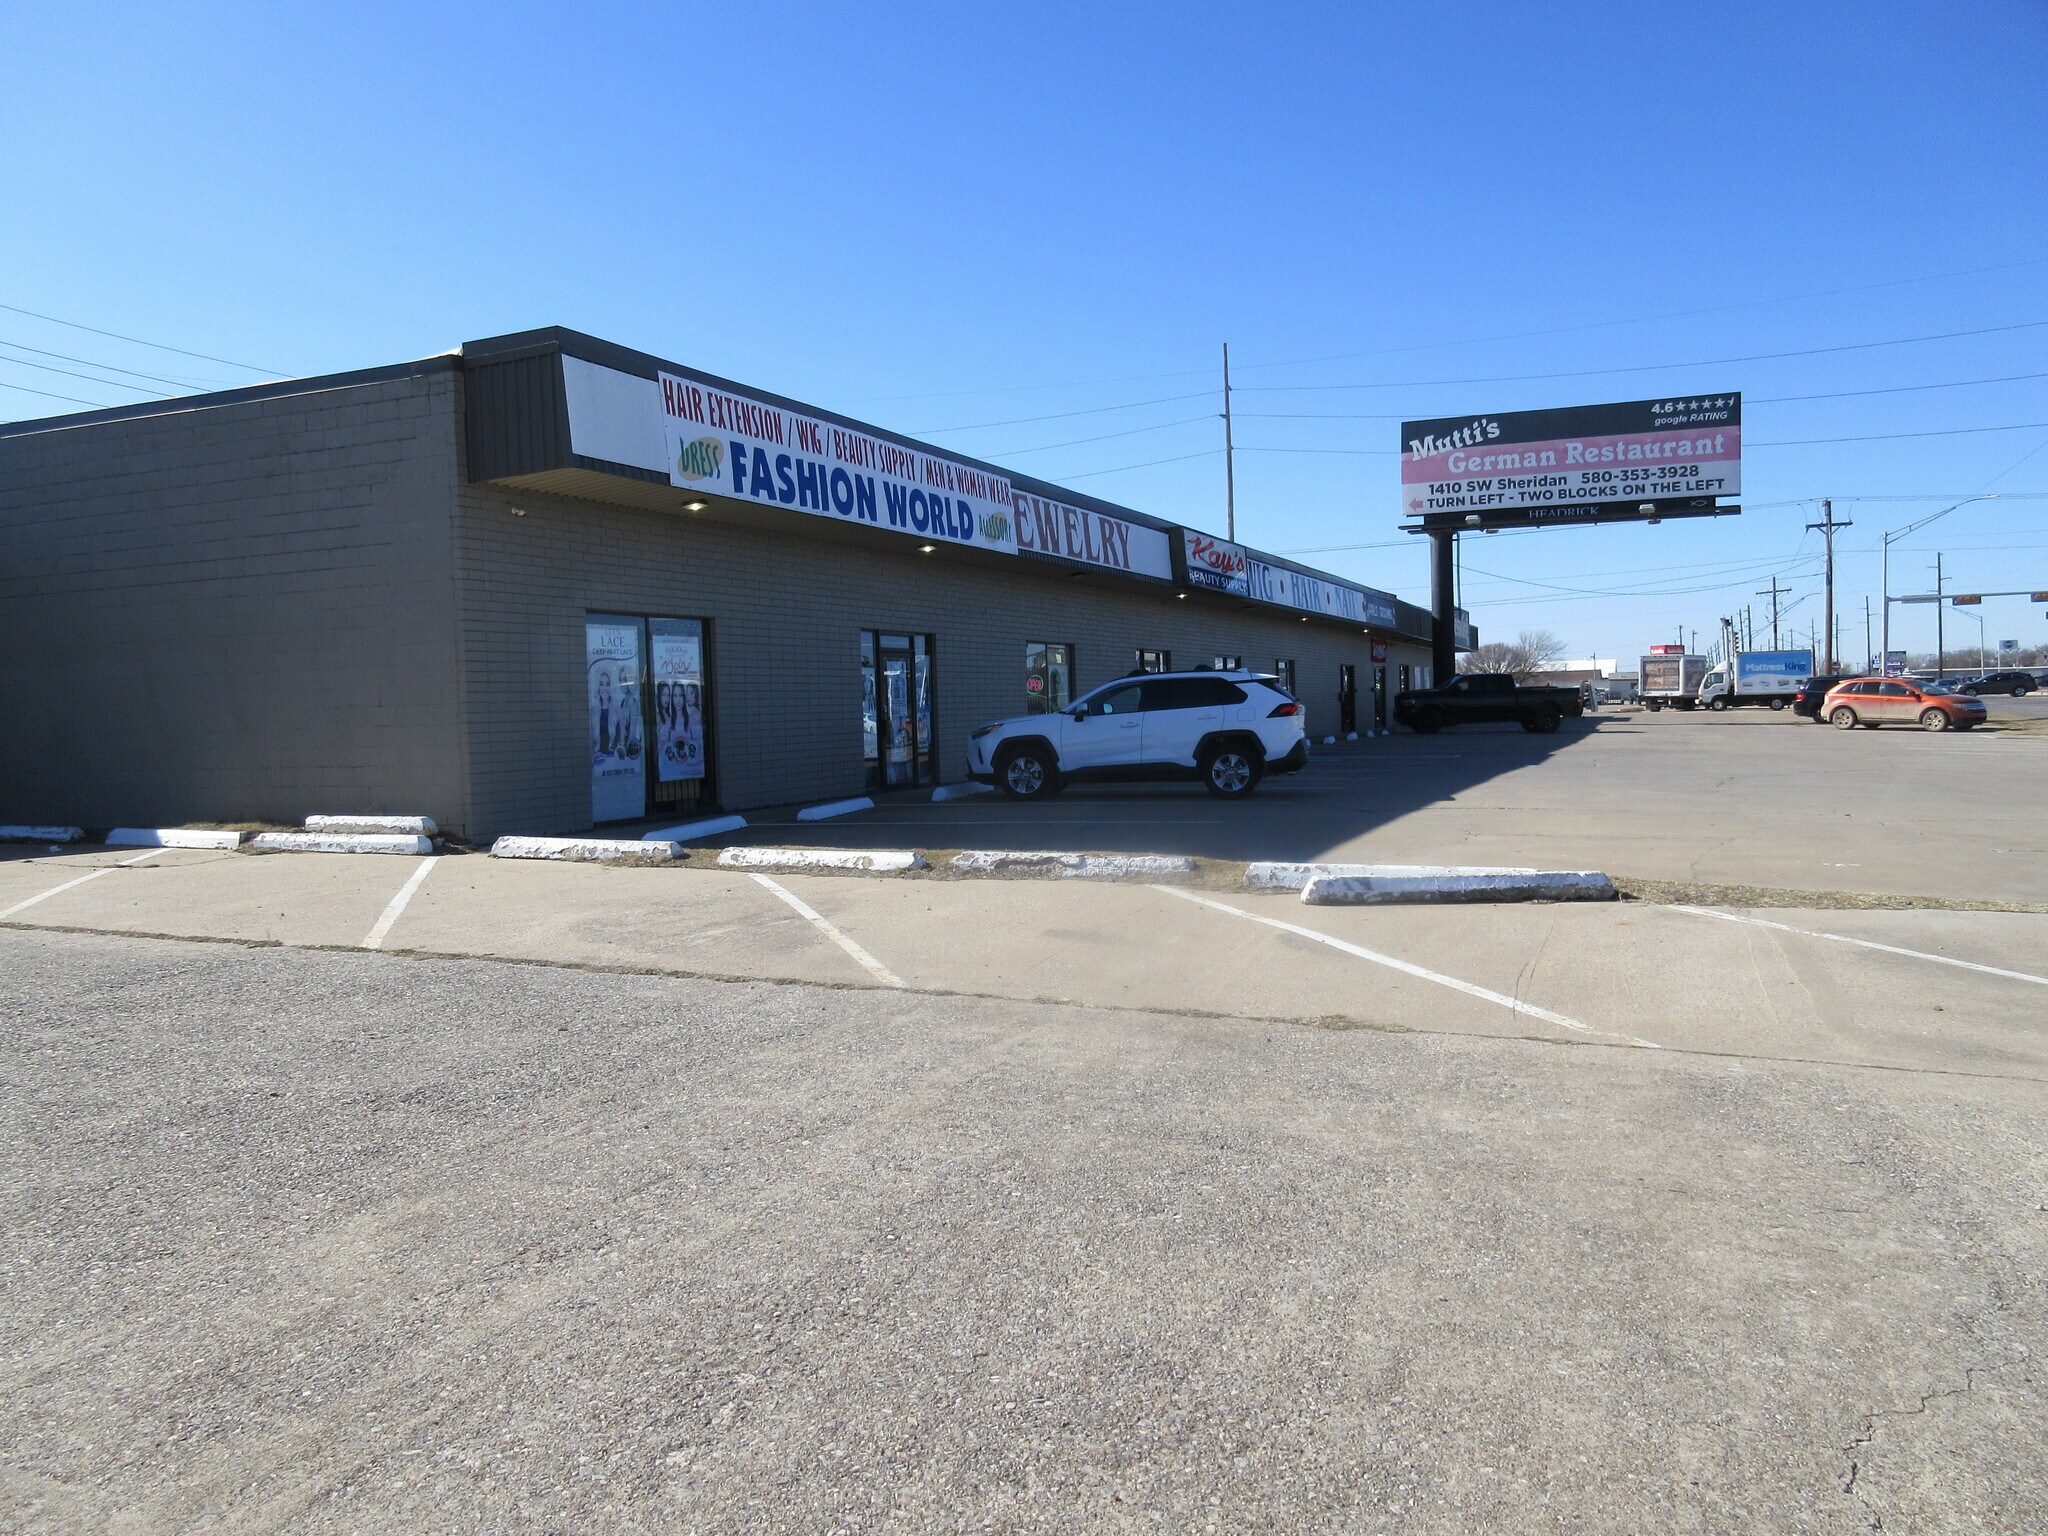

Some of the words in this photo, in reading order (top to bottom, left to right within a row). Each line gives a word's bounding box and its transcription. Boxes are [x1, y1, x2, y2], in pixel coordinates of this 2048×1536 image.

[1651, 402, 1674, 414] 4.6
[1654, 414, 1688, 426] google
[1689, 411, 1728, 422] RATING
[662, 378, 705, 424] HAIR
[706, 391, 784, 445] EXTENSION
[795, 418, 823, 455] WIG
[833, 429, 877, 470] BEAUTY
[878, 443, 916, 481] SUPPLY
[925, 458, 946, 489] MEN
[946, 464, 955, 492] &
[955, 467, 987, 500] WOMEN
[987, 477, 1012, 507] WEAR
[679, 435, 721, 479] DRESS
[1409, 418, 1500, 461] Mutti's
[1448, 449, 1557, 473] German
[1565, 433, 1725, 465] Restaurant
[729, 440, 877, 522] FASHION
[883, 481, 974, 541] WORLD
[1427, 496, 1466, 509] TURN
[1469, 493, 1505, 506] LEFT
[1518, 490, 1554, 502] TWO
[1558, 484, 1618, 499] BLOCKS
[1622, 484, 1646, 495] ON
[1650, 482, 1681, 494] THE
[1685, 478, 1725, 491] LEFT
[1428, 482, 1462, 495] 1410
[1466, 479, 1493, 492] SW
[1497, 475, 1568, 490] Sheridan
[1581, 465, 1700, 484] 580-353-3928
[1011, 492, 1131, 570] EWELRY
[1529, 506, 1600, 518] HEADRICK
[1187, 536, 1245, 574] Kay's
[1188, 569, 1220, 586] BEAUTY
[1221, 577, 1248, 592] SUPPLY
[1290, 573, 1321, 611] HAIR
[601, 636, 625, 647] LACE
